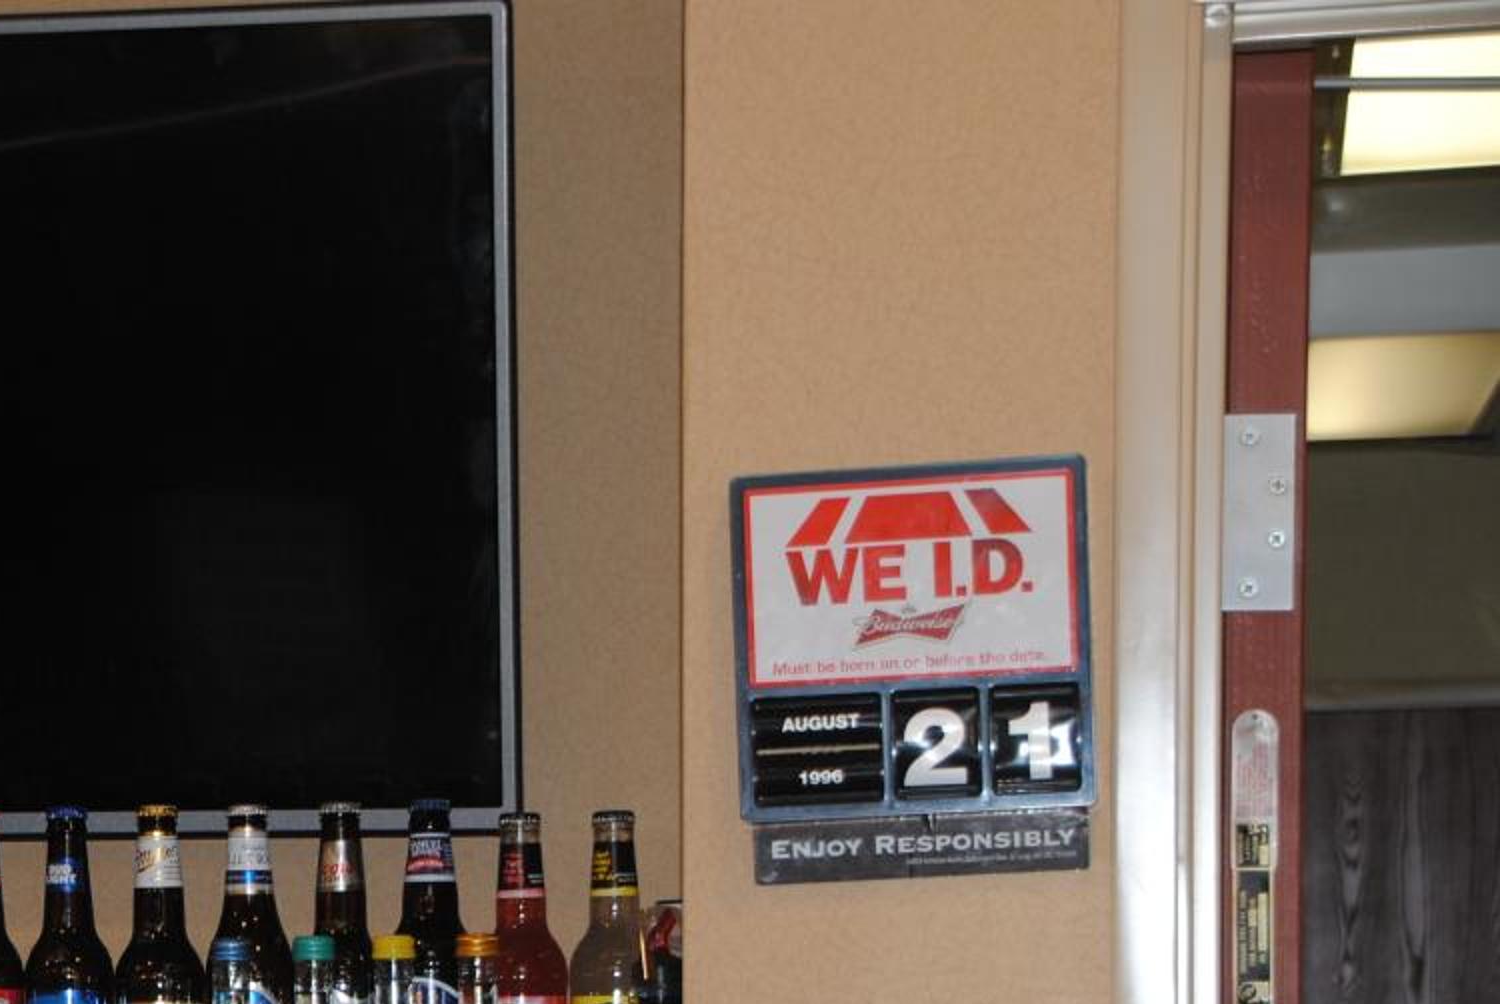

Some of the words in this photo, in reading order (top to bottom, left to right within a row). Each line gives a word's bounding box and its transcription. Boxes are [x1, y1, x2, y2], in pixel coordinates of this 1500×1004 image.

[786, 544, 906, 606] WE
[934, 538, 1032, 598] I.D.
[817, 661, 836, 673] be
[781, 713, 861, 734] AUGUST
[903, 706, 968, 788] 2
[798, 769, 844, 785] 1996
[771, 837, 863, 861] ENJOY
[875, 828, 1076, 857] RESPONSIBLY
